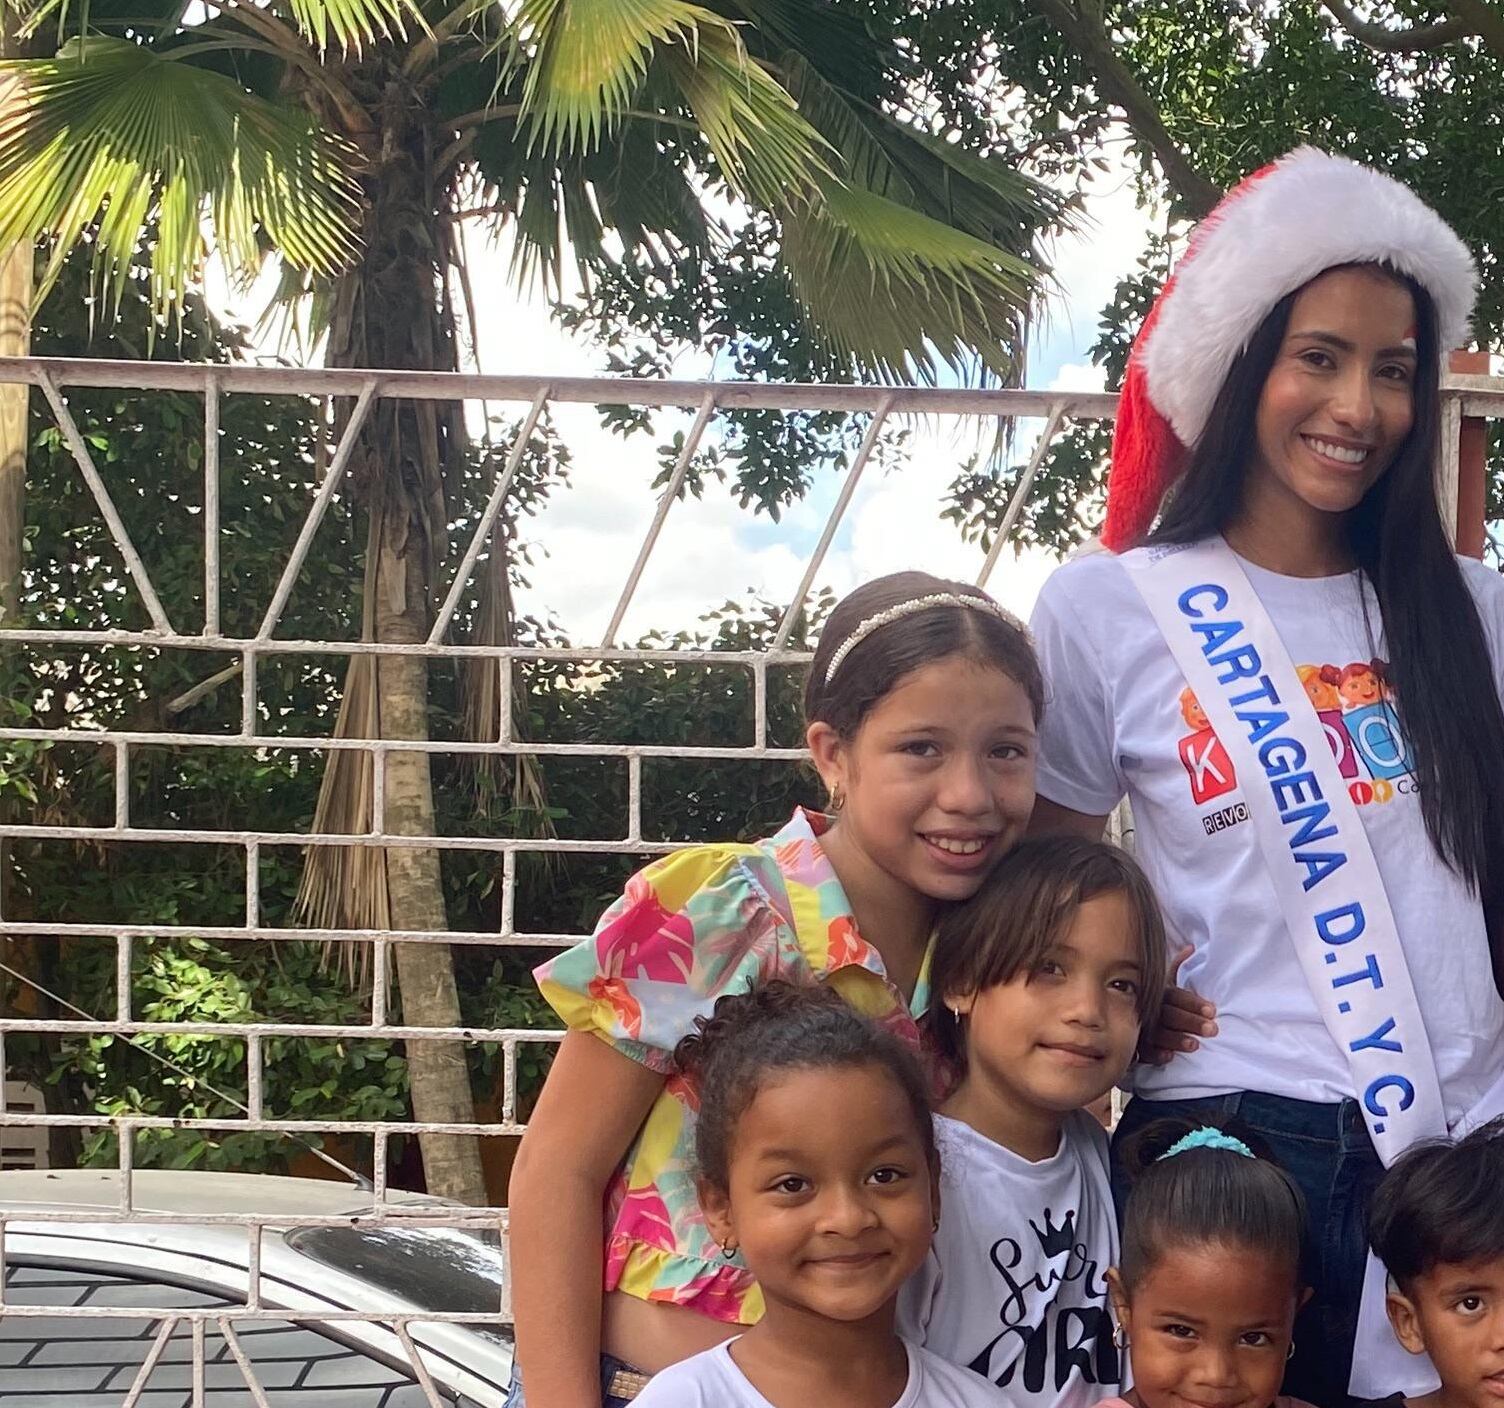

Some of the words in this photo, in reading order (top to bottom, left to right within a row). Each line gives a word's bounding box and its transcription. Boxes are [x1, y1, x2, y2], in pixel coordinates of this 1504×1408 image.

[1177, 583, 1348, 893] CARTAGENA
[1349, 1016, 1403, 1054] Y
[1364, 1073, 1415, 1136] C.
